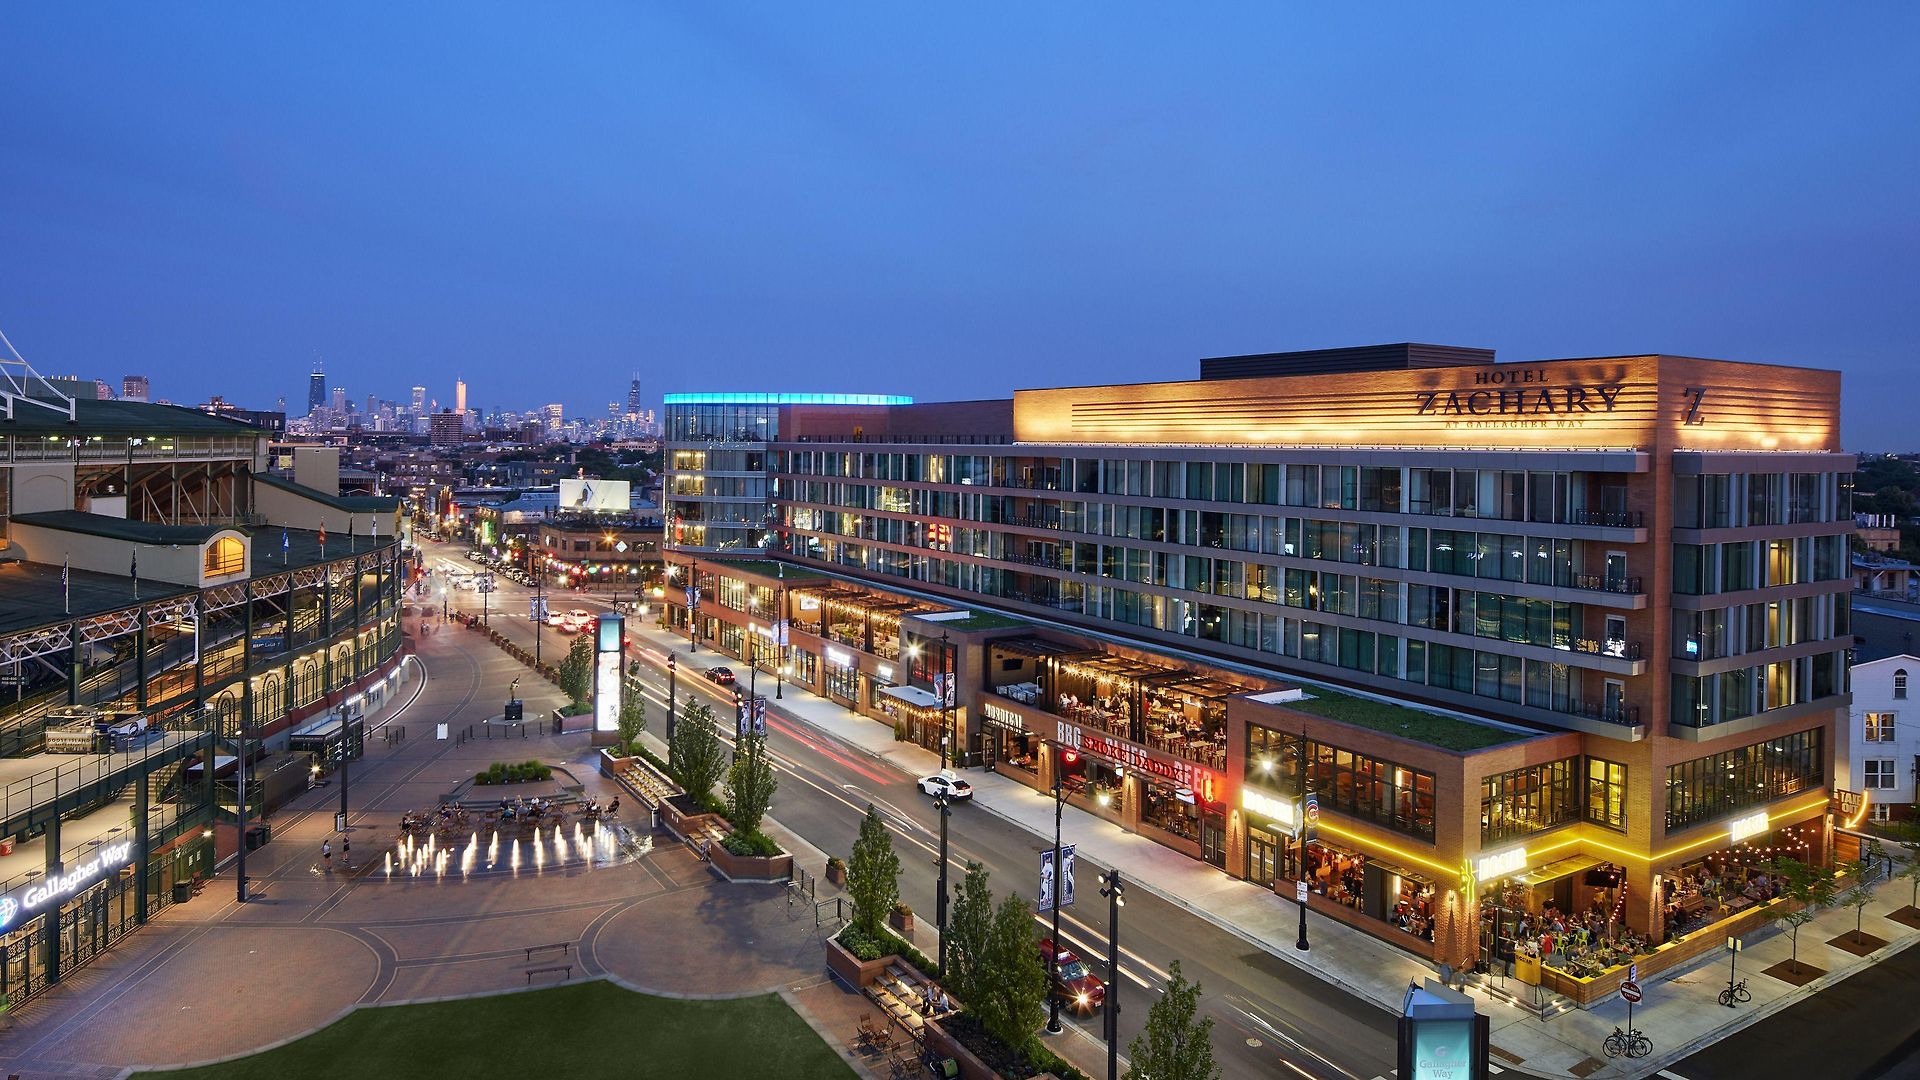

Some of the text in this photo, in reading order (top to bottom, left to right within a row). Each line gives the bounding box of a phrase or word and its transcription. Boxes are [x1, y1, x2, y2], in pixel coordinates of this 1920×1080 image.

[1475, 370, 1549, 385] HOTEL
[1416, 386, 1626, 416] ZACHARY
[1684, 387, 1707, 426] Z
[1466, 420, 1547, 428] GALLAGHER
[1556, 420, 1584, 428] WAY
[1057, 720, 1081, 750] BBQ
[1841, 791, 1861, 804] TAKE
[23, 841, 131, 908] Gallagher Way
[1420, 1060, 1466, 1070] Gallagher
[1432, 1069, 1453, 1079] Way
